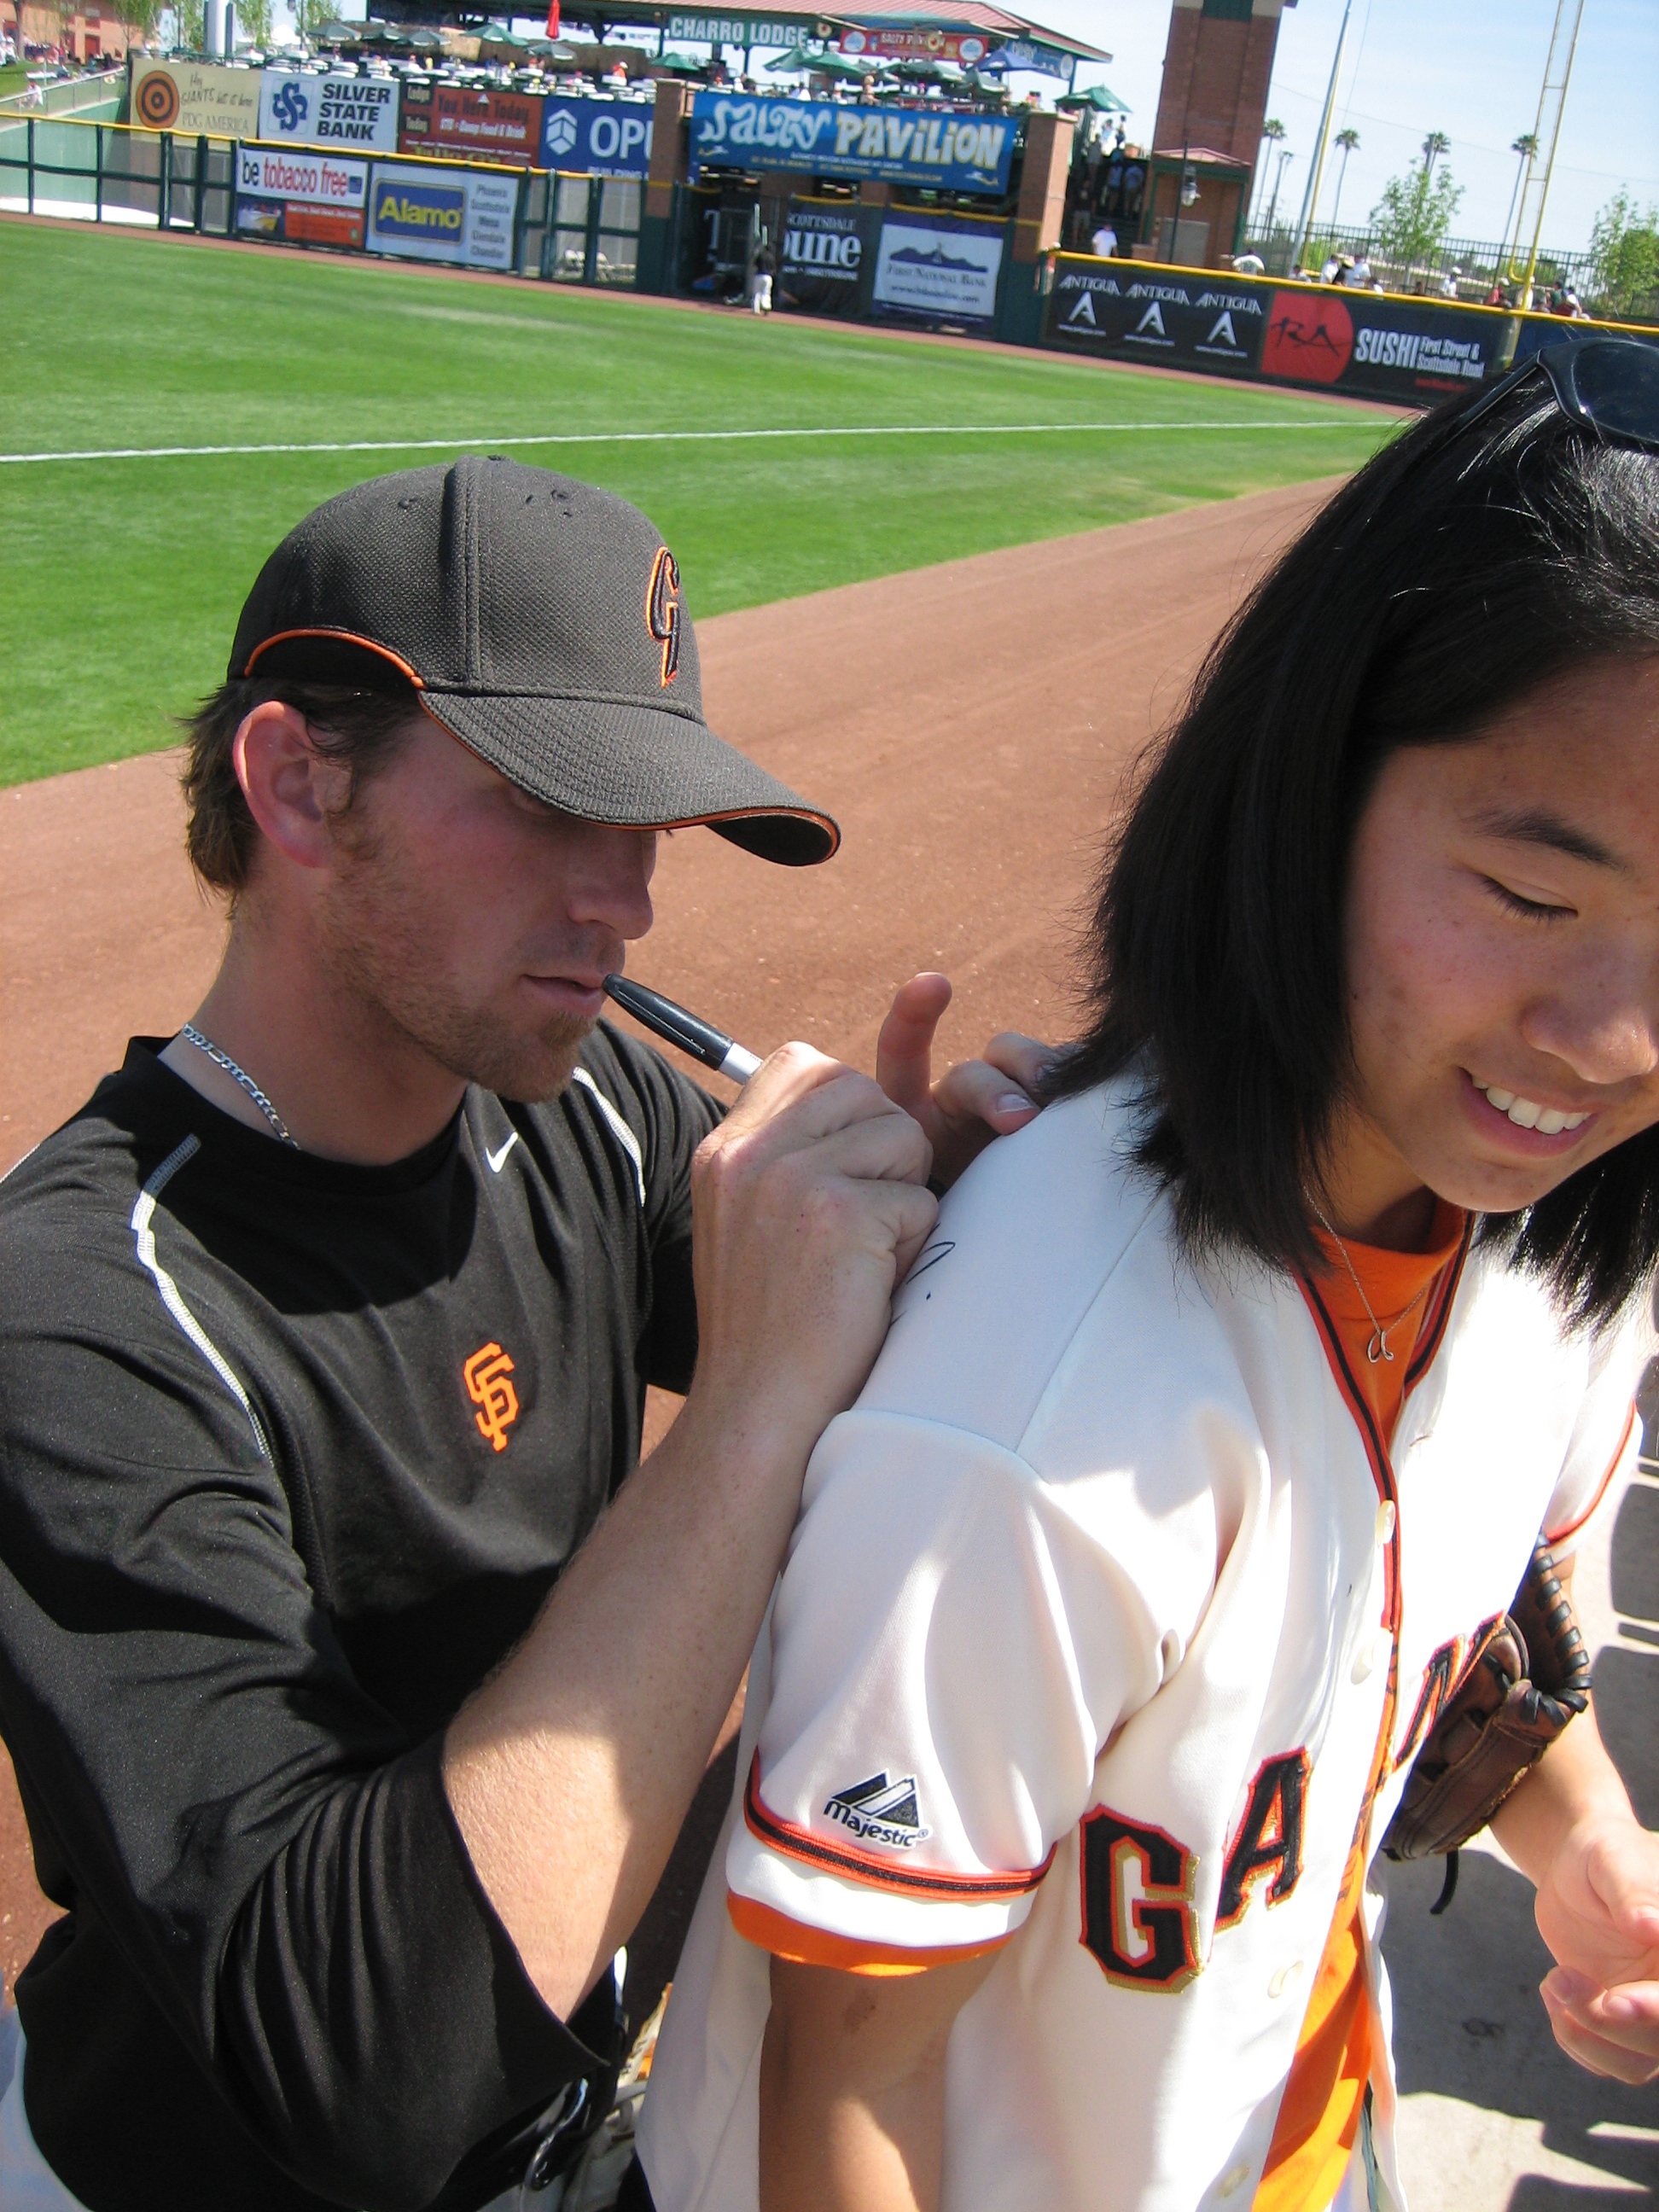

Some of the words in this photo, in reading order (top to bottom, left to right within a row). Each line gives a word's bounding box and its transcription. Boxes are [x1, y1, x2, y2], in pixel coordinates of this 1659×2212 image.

[669, 18, 744, 42] CHARRO
[749, 24, 809, 46] LODGE
[322, 83, 391, 104] SILVER
[182, 112, 203, 127] PDG
[205, 115, 249, 133] AMERICA
[319, 102, 380, 123] STATE
[317, 120, 375, 141] BANK
[242, 152, 259, 186] be
[263, 154, 317, 193] tobacco
[320, 160, 349, 197] free
[377, 196, 463, 230] Alamo
[1057, 274, 1121, 297] ANTIGUA
[1125, 283, 1190, 306] ANTIGUA
[1195, 293, 1262, 317] ANTIGUA
[1271, 317, 1341, 358] RA
[1354, 327, 1421, 370] SUSHI
[1418, 335, 1442, 355] First
[463, 1336, 521, 1453] SF
[824, 1800, 917, 1848] majestic
